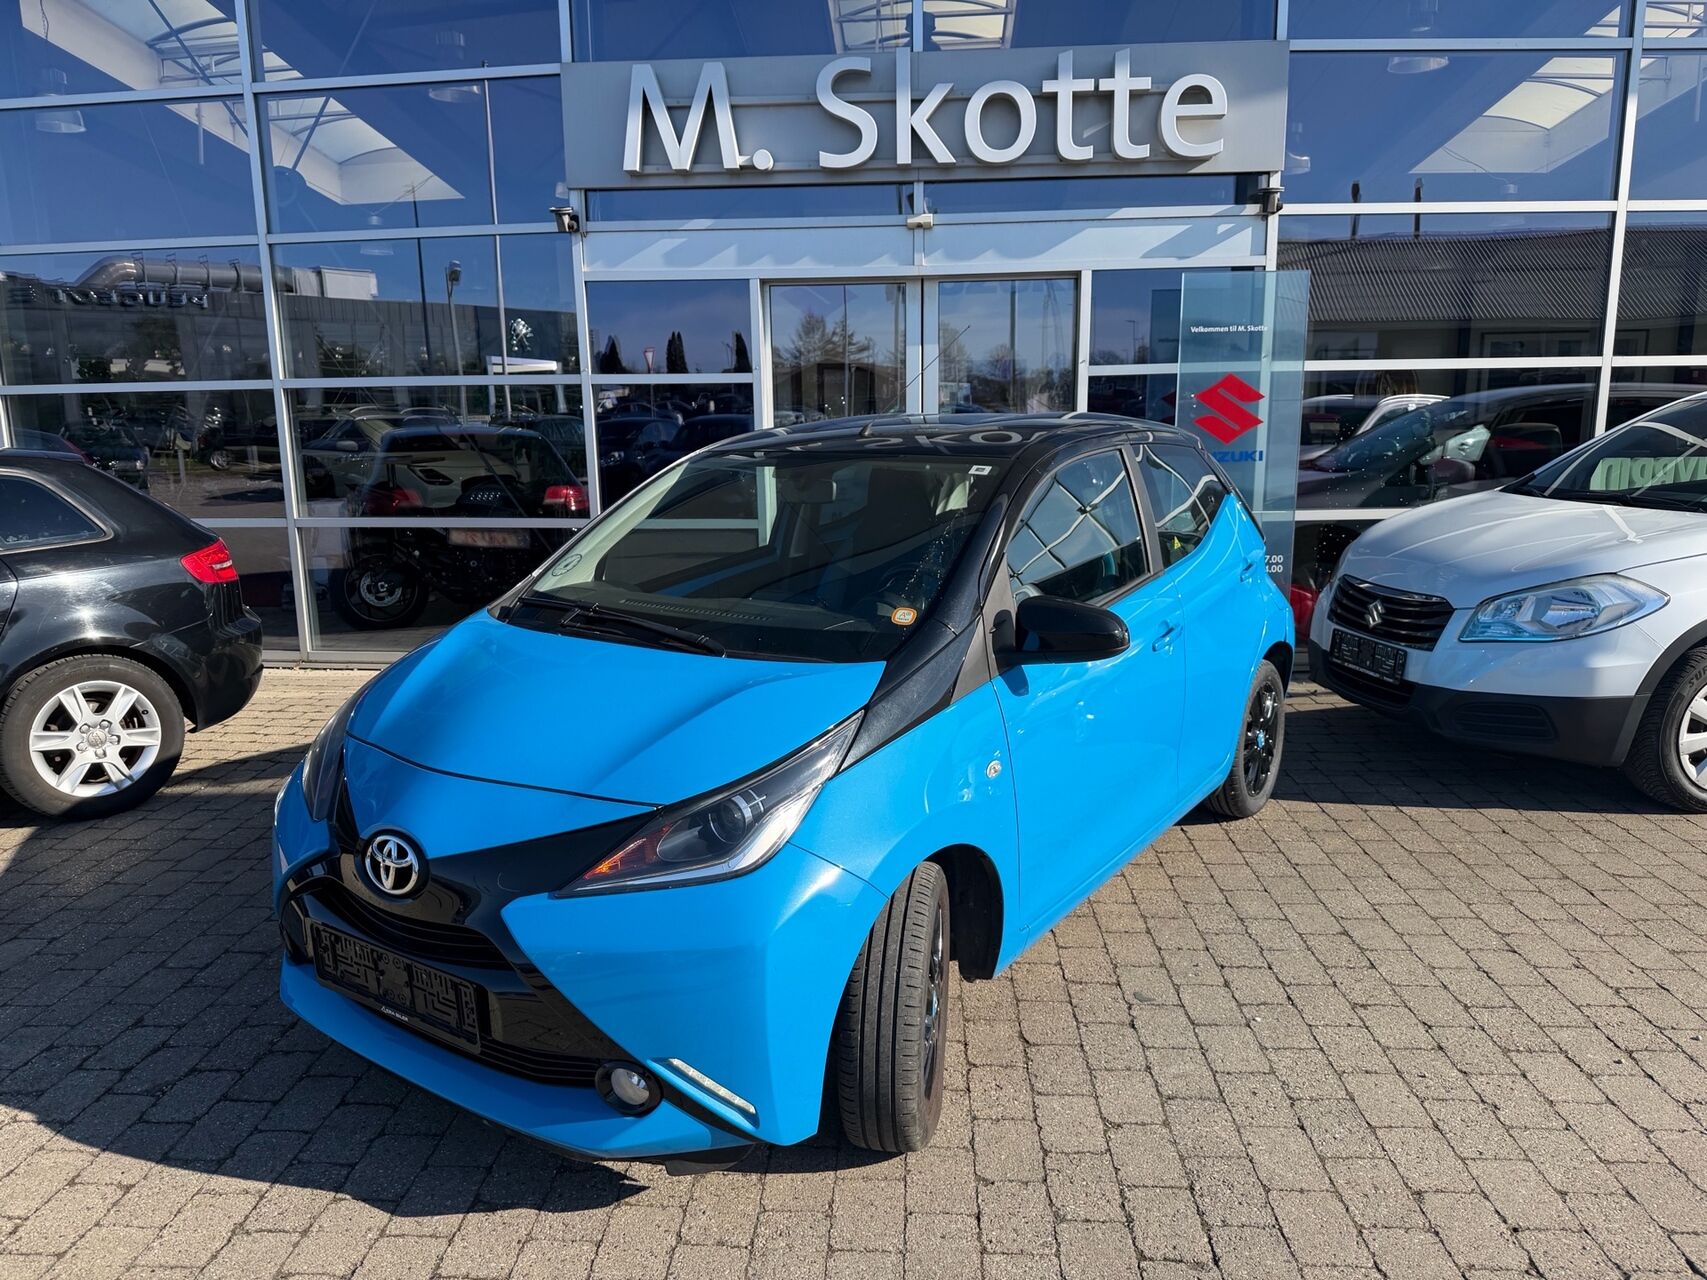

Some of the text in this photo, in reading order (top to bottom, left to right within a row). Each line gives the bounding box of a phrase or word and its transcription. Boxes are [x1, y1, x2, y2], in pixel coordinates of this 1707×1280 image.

[622, 47, 1229, 175] M. Skotte
[1190, 325, 1229, 333] Velkommen
[1247, 324, 1269, 332] Skotte
[1213, 450, 1263, 462] ZUKI
